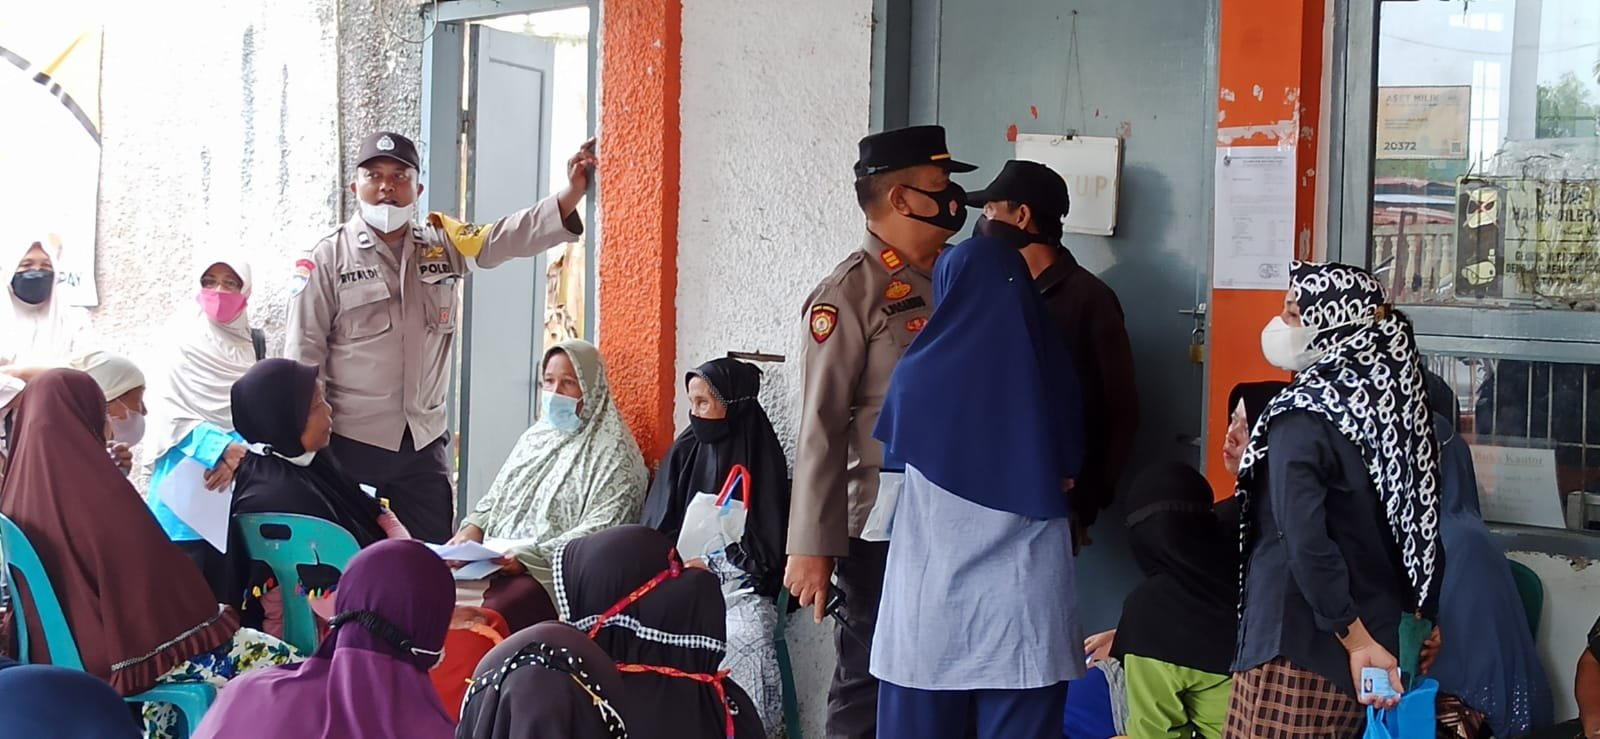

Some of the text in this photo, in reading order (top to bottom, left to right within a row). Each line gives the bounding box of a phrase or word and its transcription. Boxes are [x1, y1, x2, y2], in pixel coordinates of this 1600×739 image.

[1383, 141, 1417, 151] 20372
[341, 268, 378, 284] RIZALDI
[1504, 453, 1543, 465] Kantor
